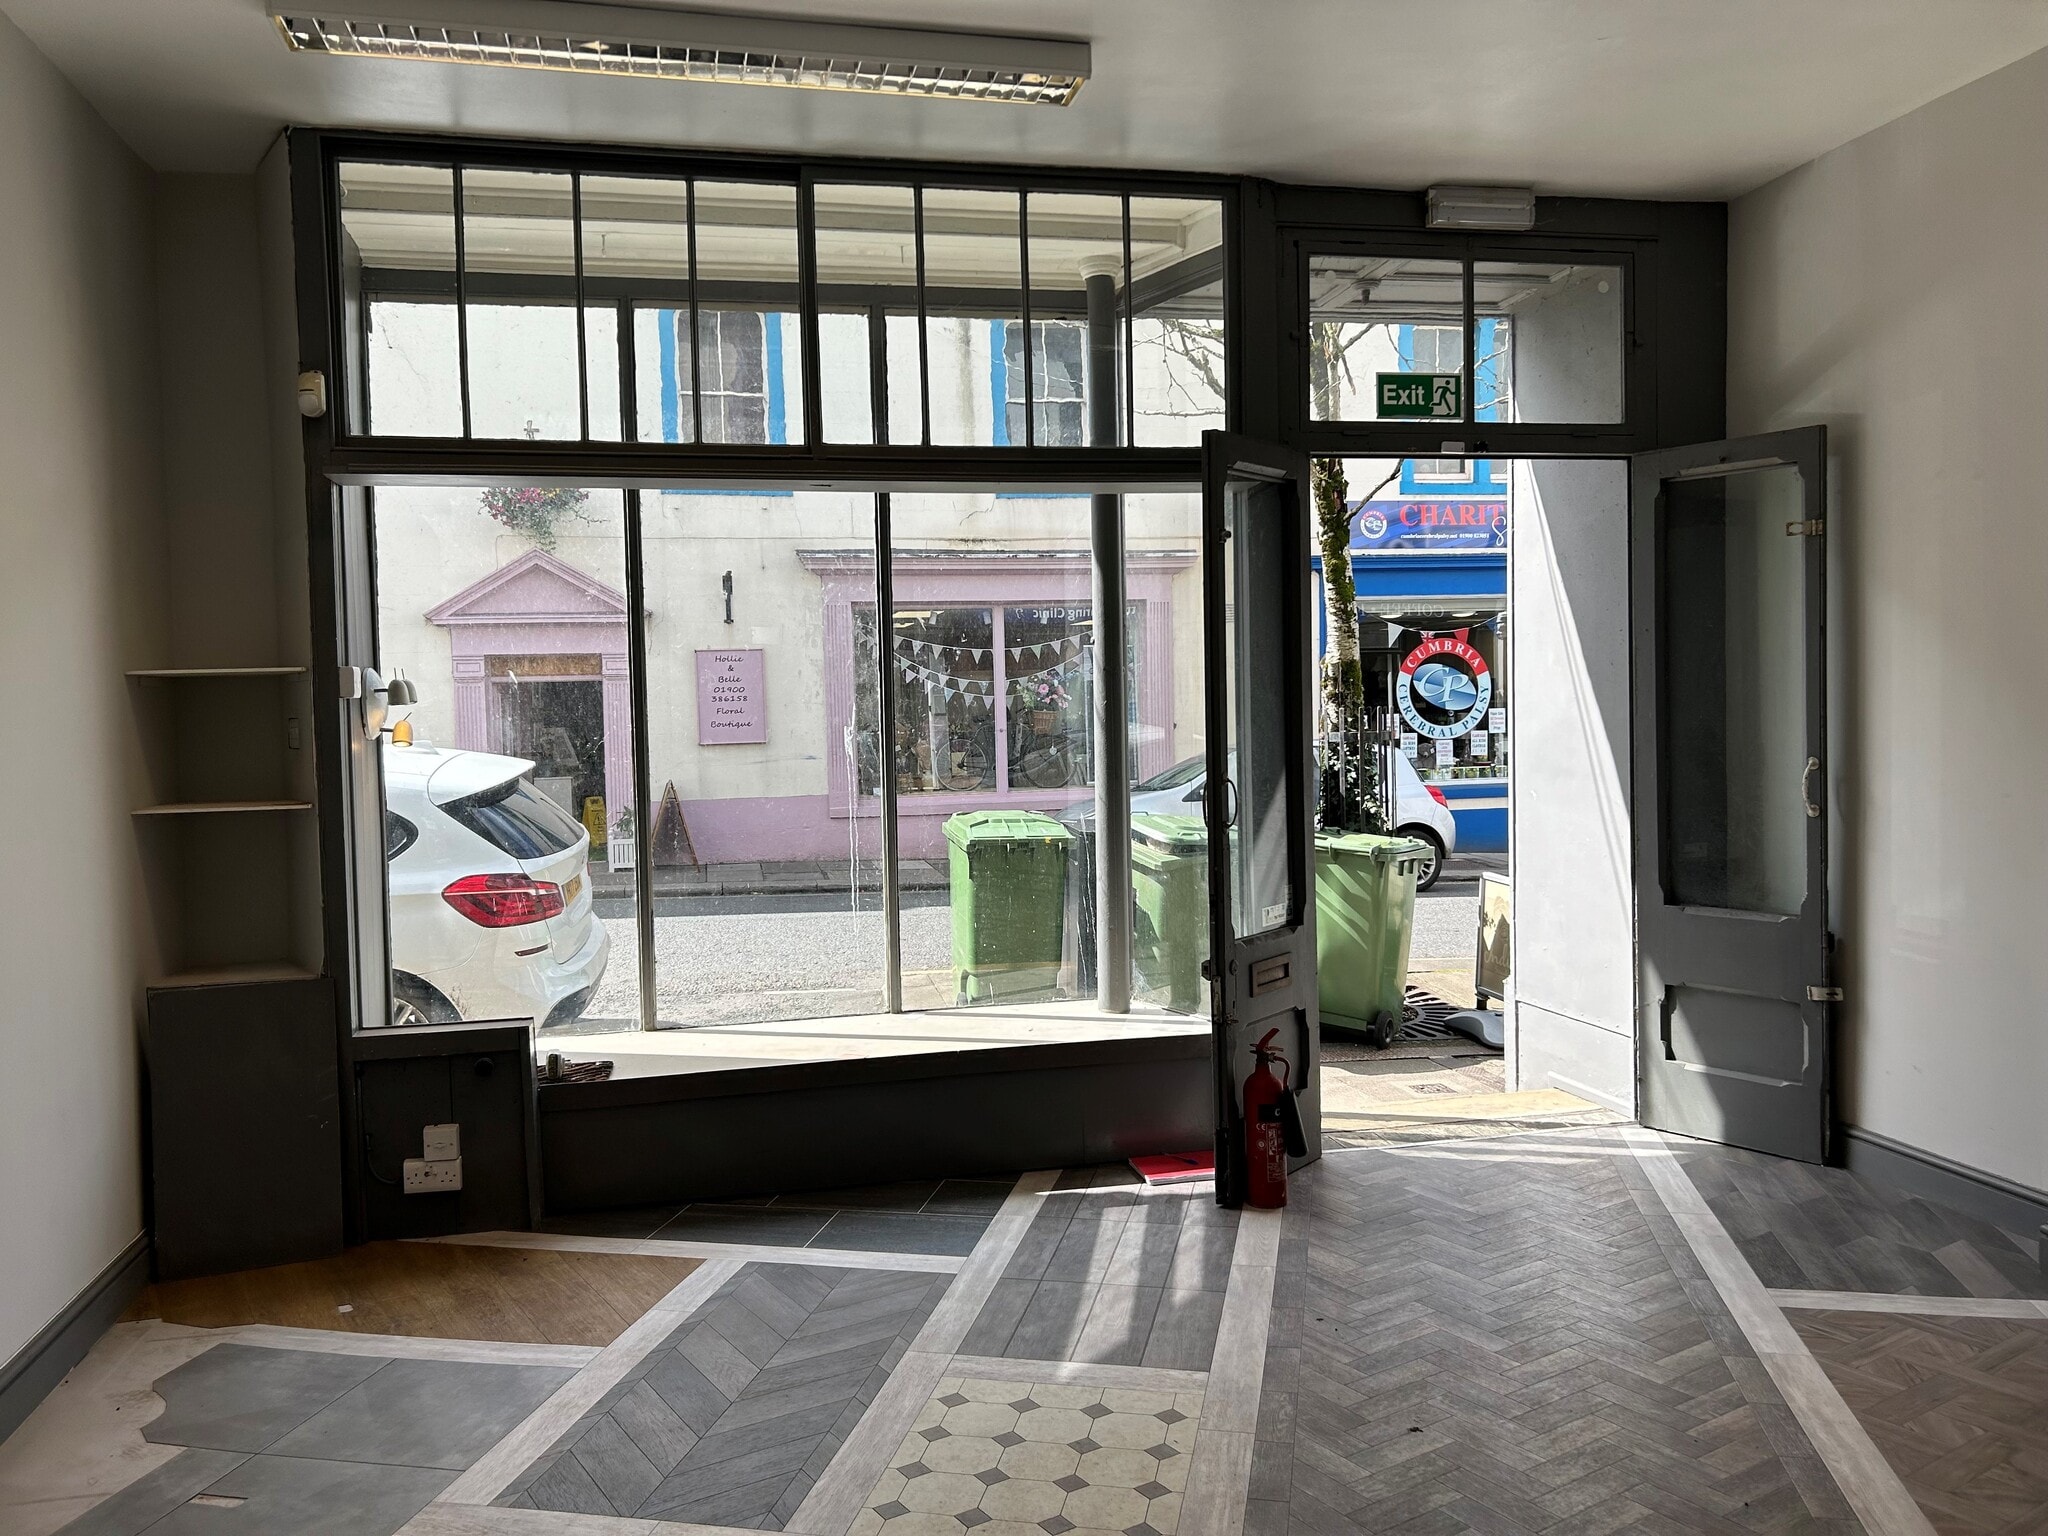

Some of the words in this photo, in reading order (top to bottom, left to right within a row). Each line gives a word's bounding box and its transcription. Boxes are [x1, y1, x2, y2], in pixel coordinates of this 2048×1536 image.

[1383, 384, 1425, 405] Exit
[1400, 504, 1505, 526] CHARIT
[714, 655, 744, 663] Hollie
[1406, 640, 1481, 668] CUMBRIA
[1420, 667, 1469, 704] CP
[711, 695, 748, 703] 386158
[716, 707, 745, 715] Floral
[1398, 684, 1457, 738] CEREBRAL
[1461, 685, 1489, 730] PALSY
[710, 720, 752, 729] Boutique
